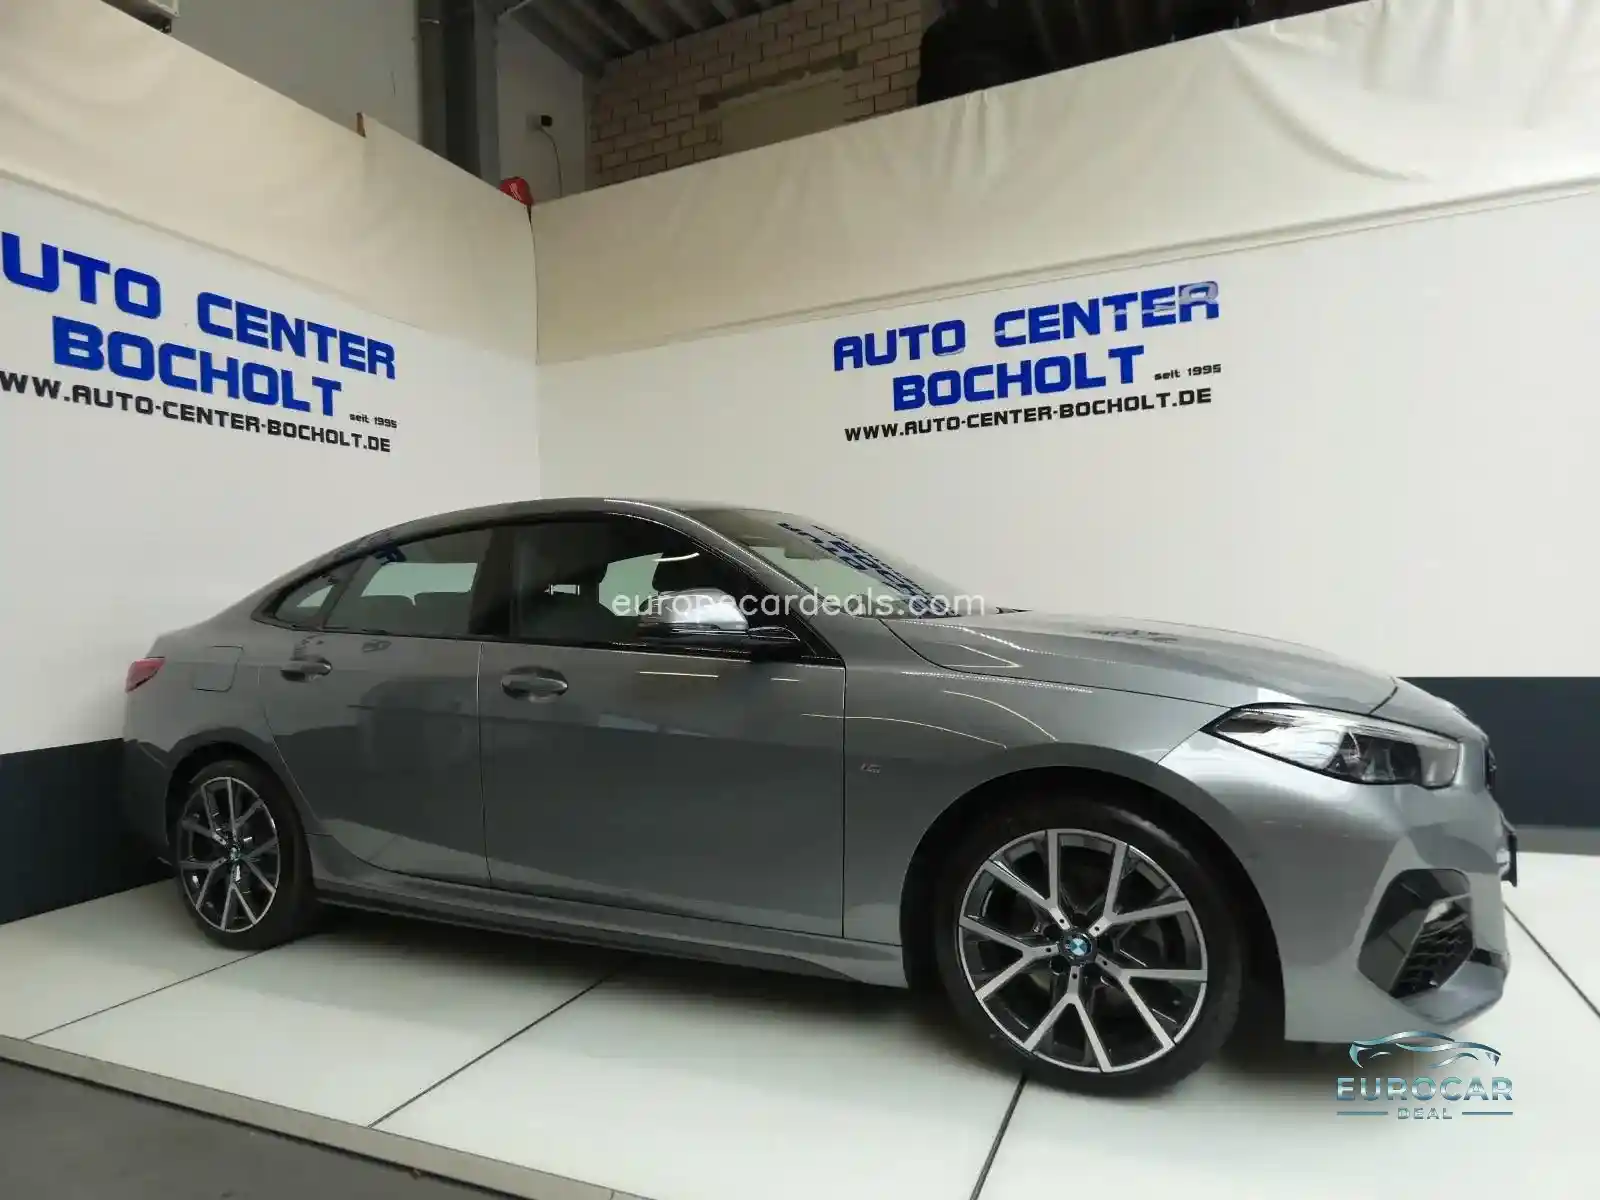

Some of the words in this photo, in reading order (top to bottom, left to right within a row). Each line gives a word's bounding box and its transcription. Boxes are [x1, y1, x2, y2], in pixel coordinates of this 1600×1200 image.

[2, 231, 162, 320] UTO
[197, 292, 396, 380] CENTER
[833, 319, 966, 371] AUTO
[994, 281, 1220, 348] CENTER
[52, 316, 342, 416] BOCHOLT
[349, 413, 370, 424] seit
[374, 416, 397, 429] 1995
[844, 387, 1212, 442] WWW.AUTO-CENTER-BOCHOLT.DE
[893, 345, 1145, 411] BOCHOLT
[1154, 369, 1181, 380] seit
[1187, 363, 1222, 377] 1995
